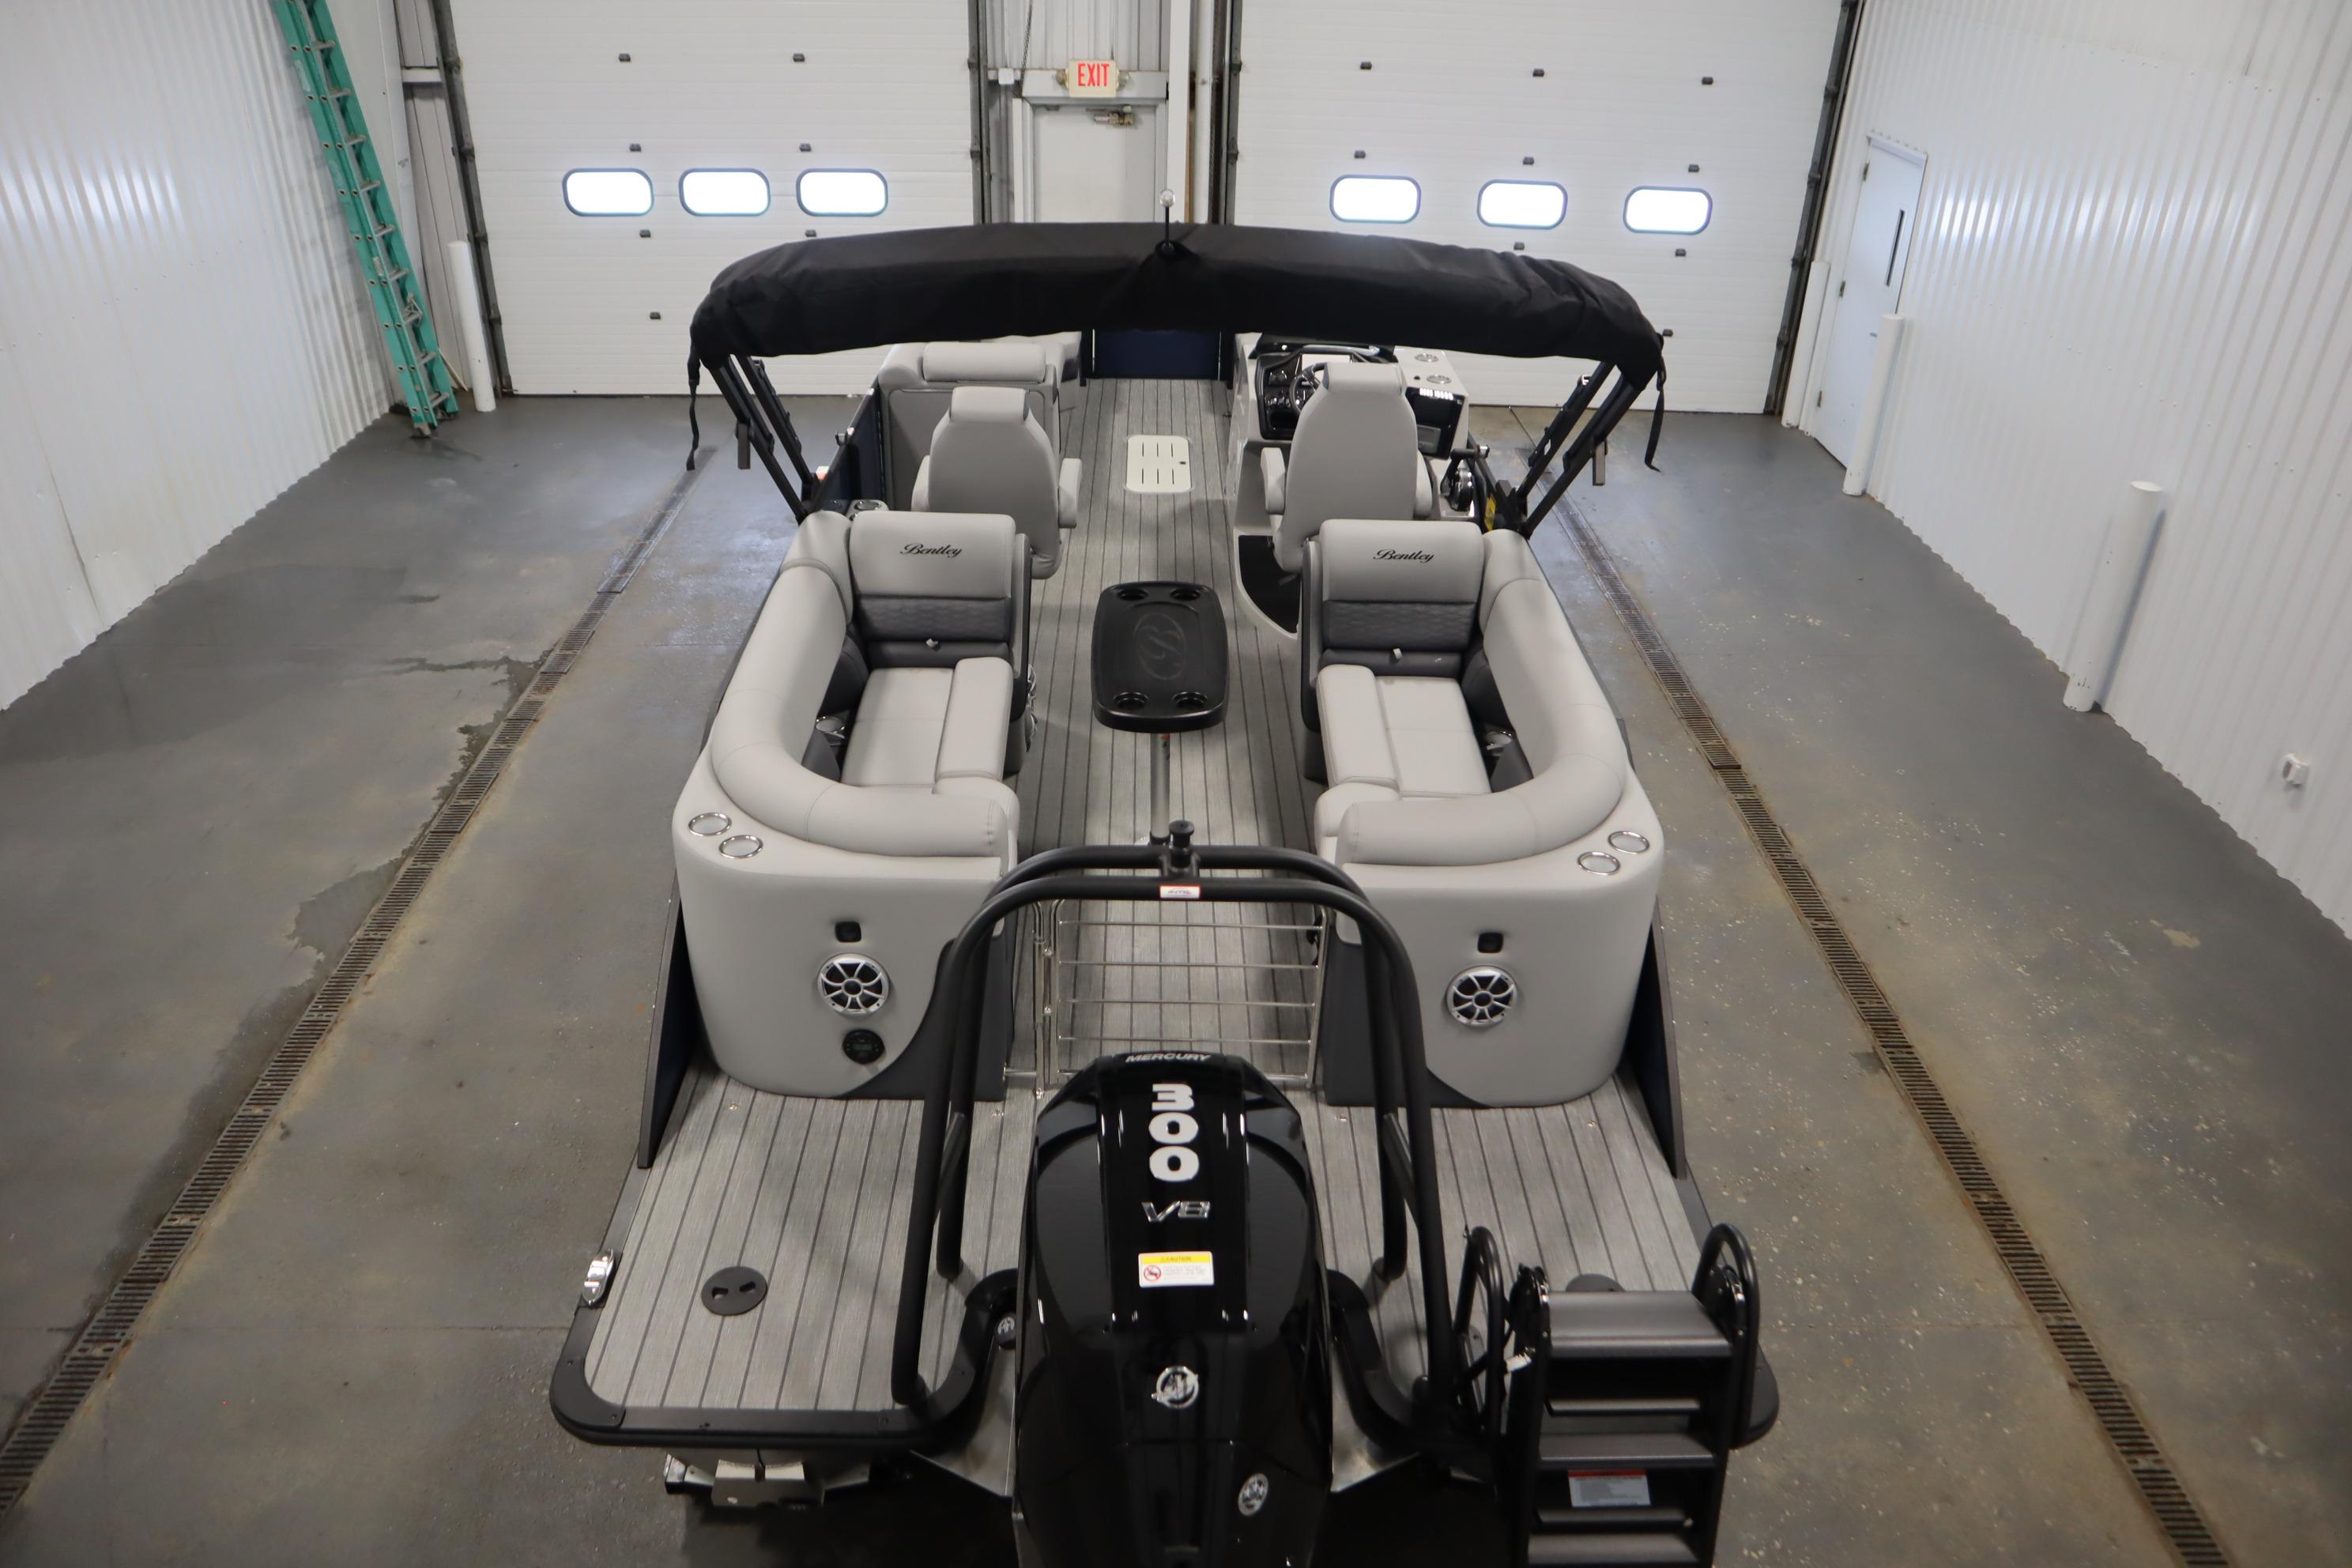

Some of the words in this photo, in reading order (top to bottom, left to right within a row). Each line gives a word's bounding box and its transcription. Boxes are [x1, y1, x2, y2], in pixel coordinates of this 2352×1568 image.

[1077, 62, 1110, 87] EXIT
[899, 542, 963, 558] Bentley
[1373, 548, 1434, 564] Bentley
[1125, 1053, 1212, 1063] MERCURY
[1148, 1083, 1200, 1182] 300
[1141, 1200, 1210, 1222] V8
